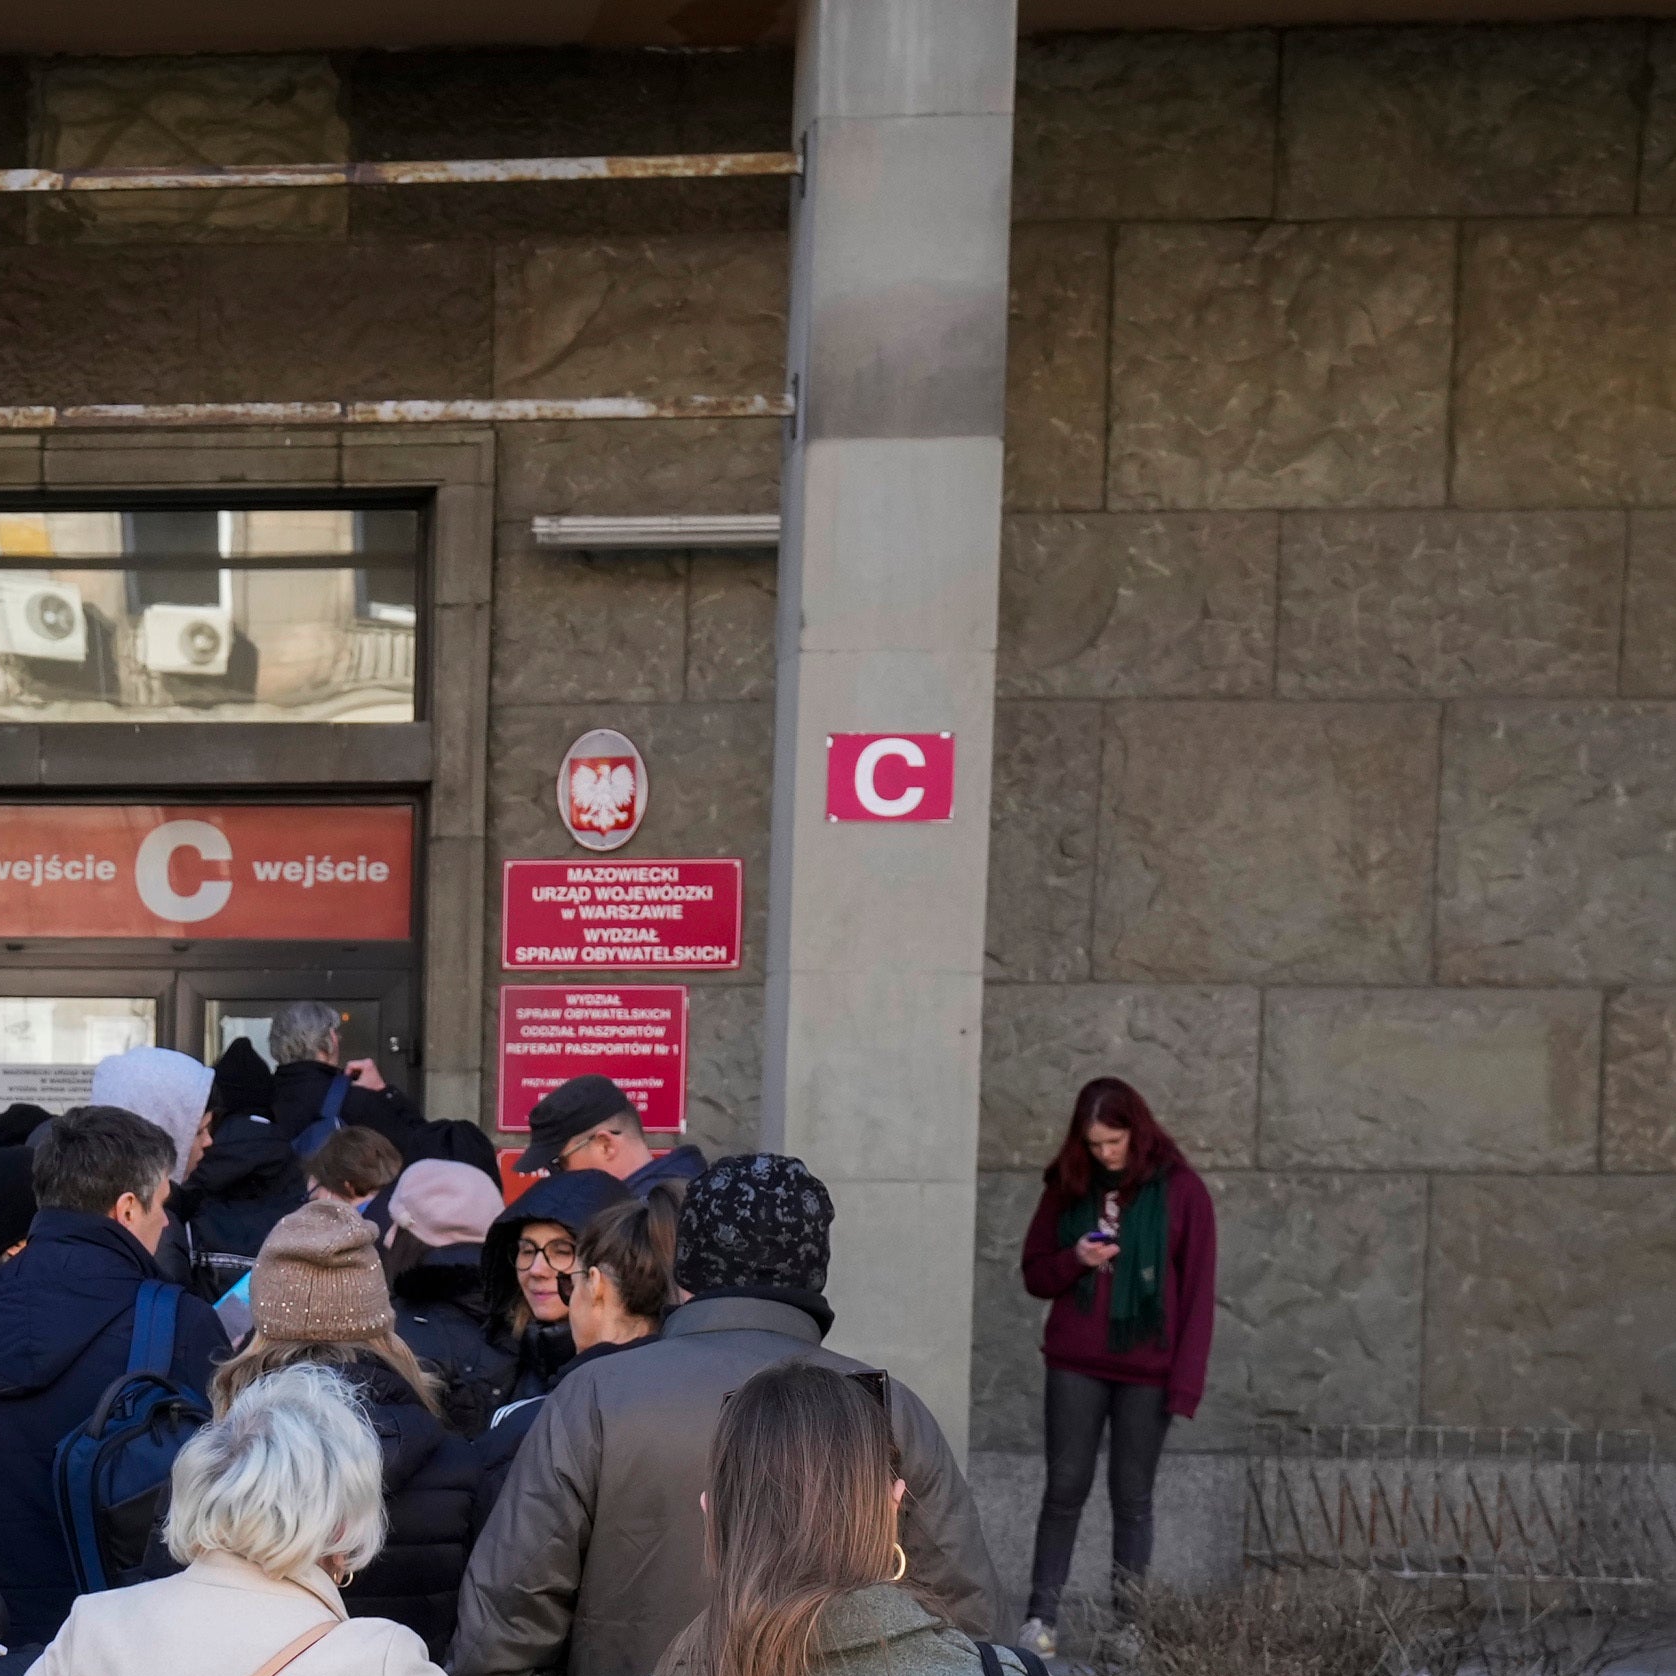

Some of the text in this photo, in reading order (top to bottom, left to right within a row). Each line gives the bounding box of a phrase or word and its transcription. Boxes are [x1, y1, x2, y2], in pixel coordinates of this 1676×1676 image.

[854, 737, 926, 817] C
[135, 819, 233, 923] C
[253, 855, 390, 888] wejście
[567, 867, 679, 882] MAZOWIECKI
[532, 883, 713, 904] URZĄD WOJEWÓDZKI
[579, 905, 683, 919] WARSZAWIE
[584, 928, 660, 942] WYDZIAŁ
[515, 946, 727, 962] SPRAW OBYWATELSKICH
[516, 1008, 671, 1020] SPRAW OBYWATELSKICH
[565, 1041, 652, 1056] PASZPORTÓW
